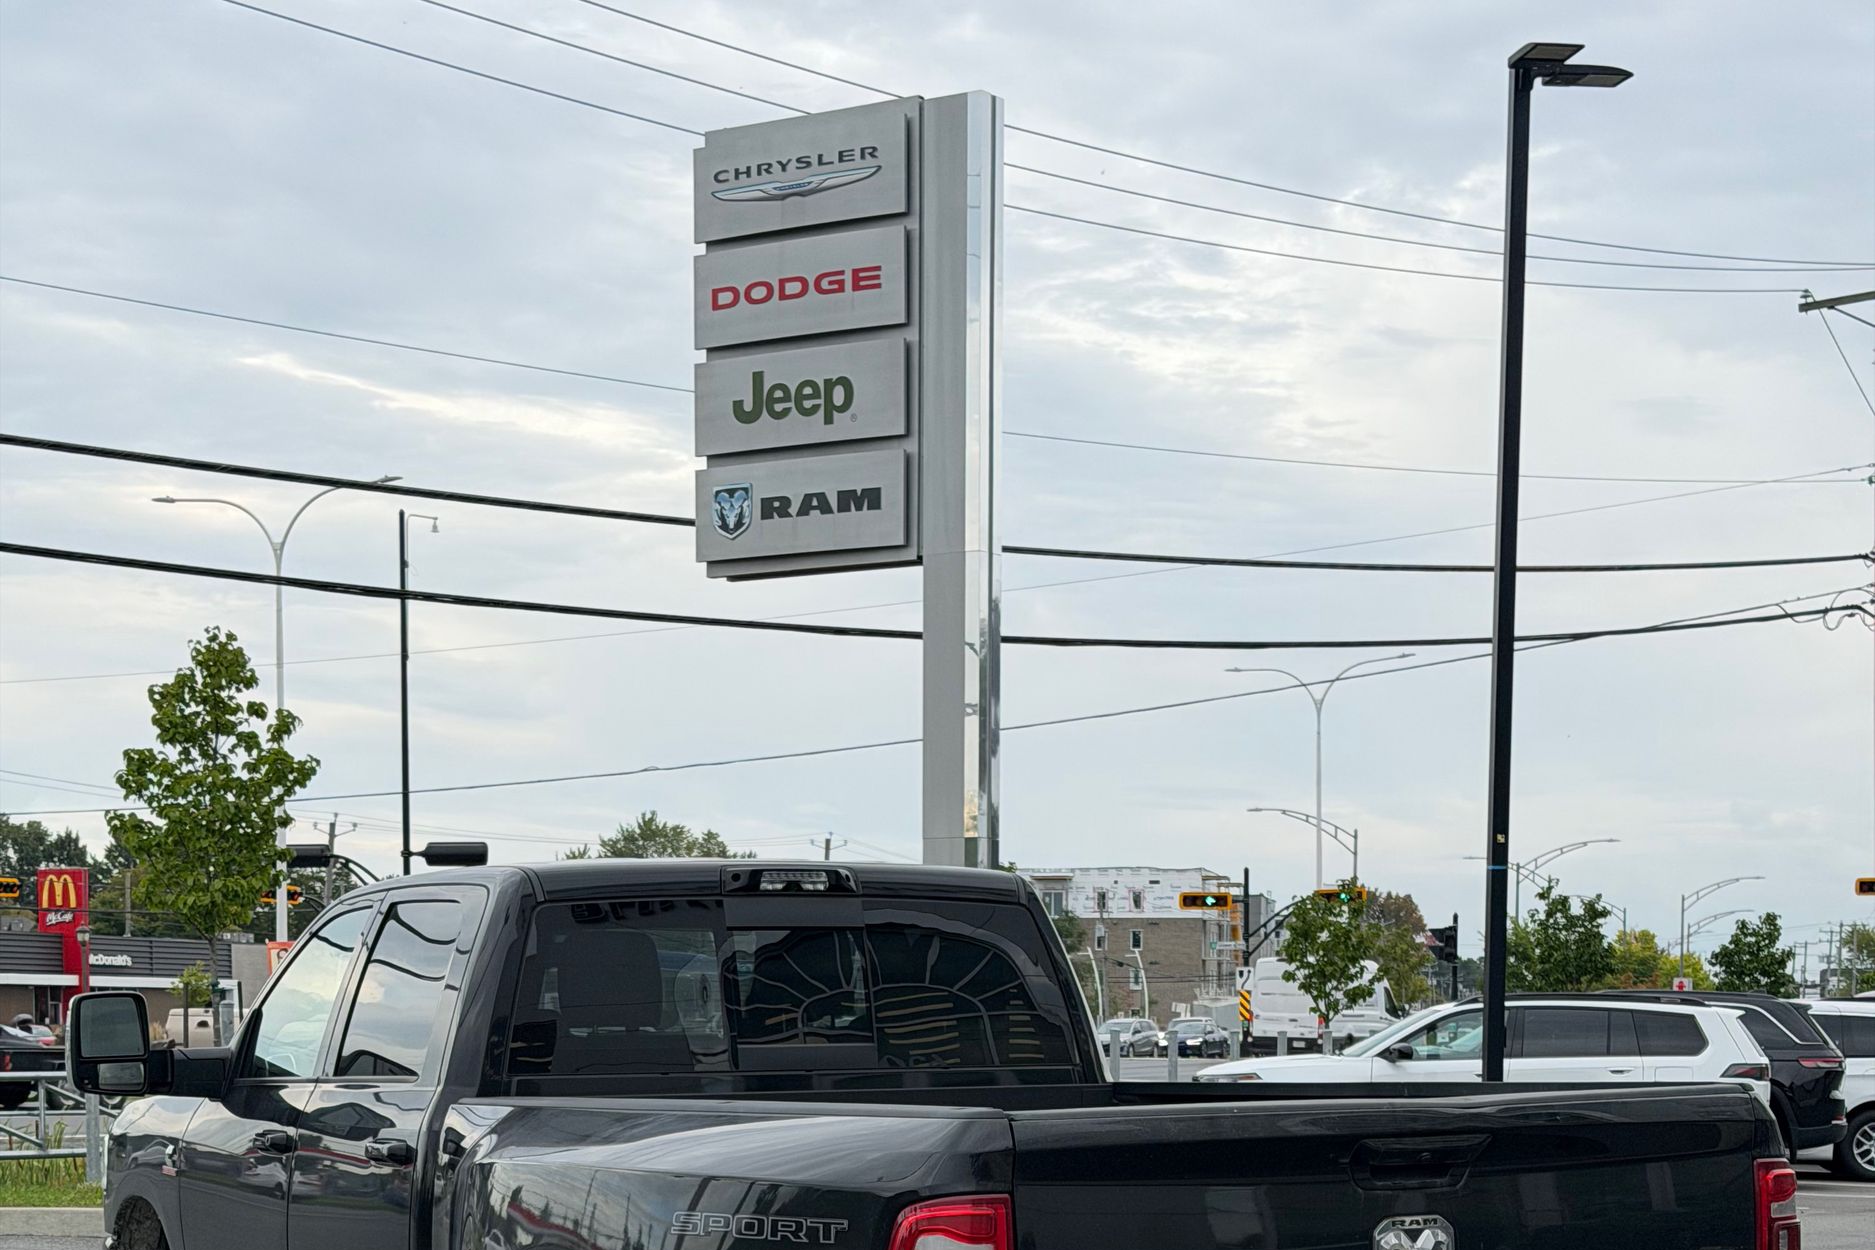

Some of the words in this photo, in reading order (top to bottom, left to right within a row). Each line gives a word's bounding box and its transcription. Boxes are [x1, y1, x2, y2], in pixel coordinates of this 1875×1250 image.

[712, 145, 880, 184] CHRYSLER
[710, 264, 883, 312] DODGE
[732, 370, 855, 426] Jeep
[760, 486, 883, 521] RAM
[670, 1211, 849, 1244] SPORT
[1391, 1218, 1438, 1228] RAM
